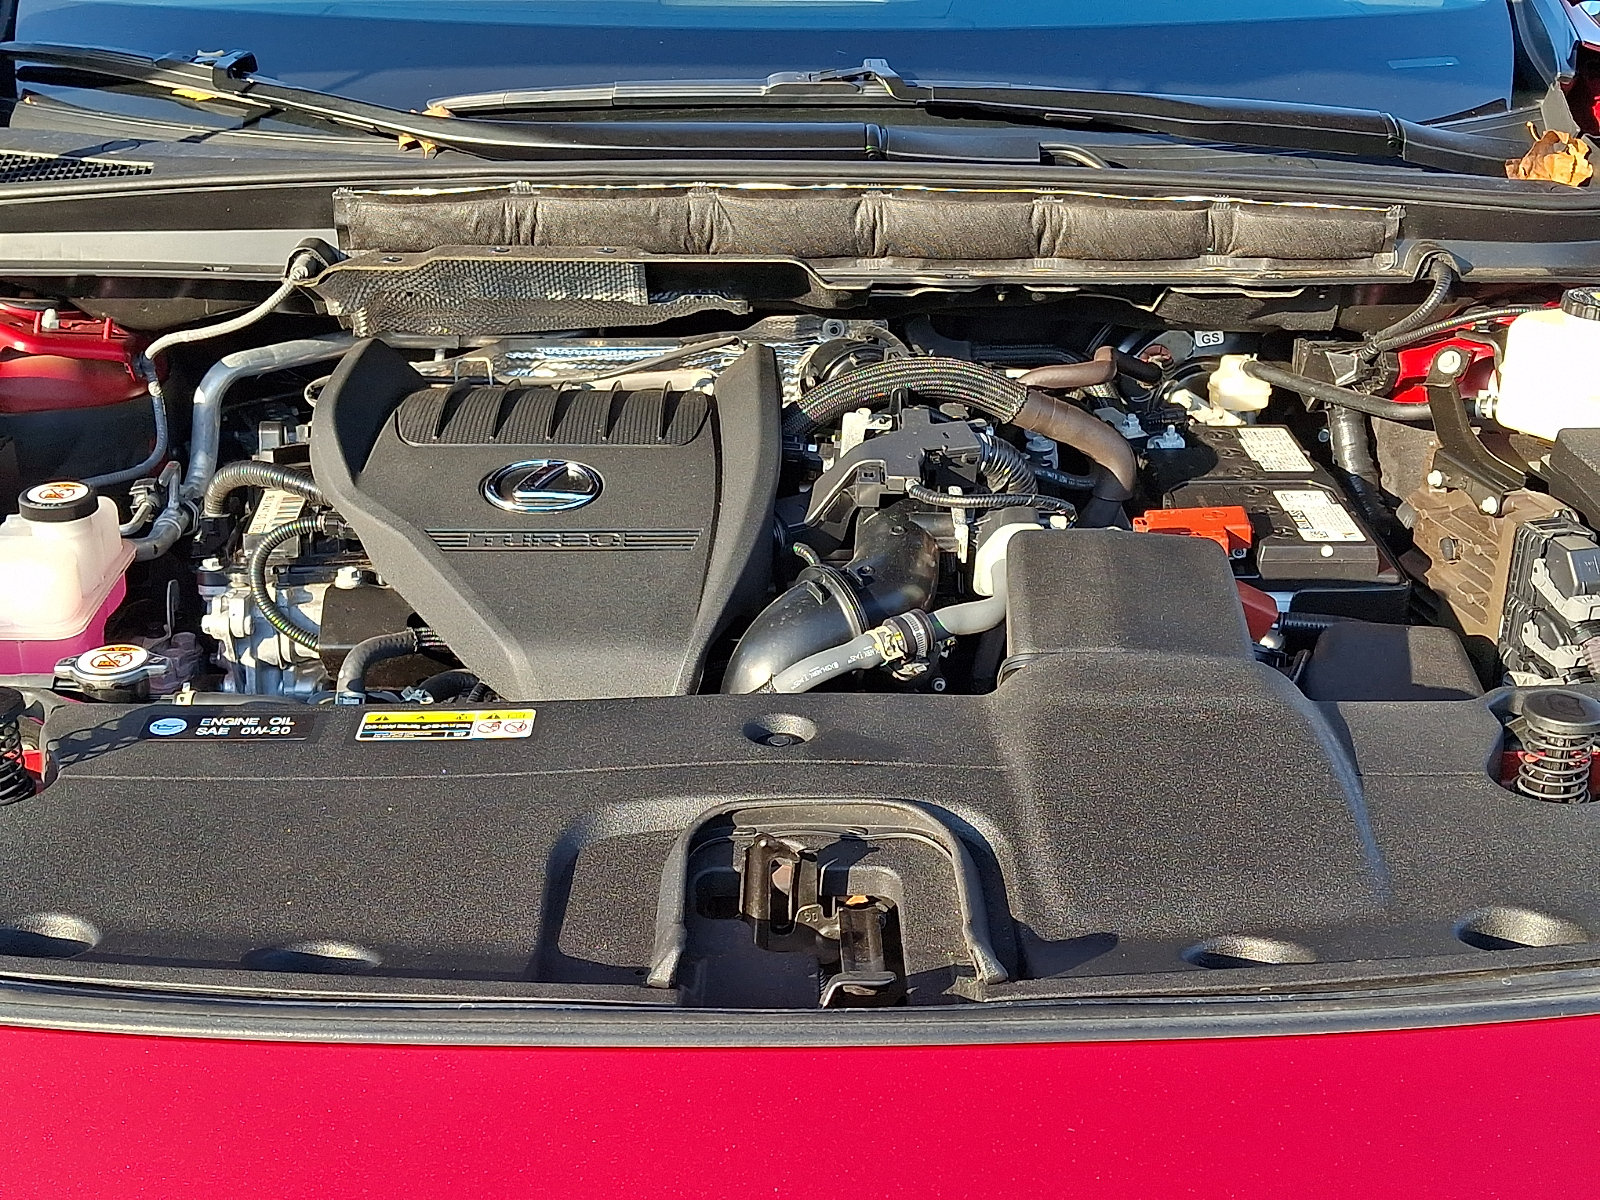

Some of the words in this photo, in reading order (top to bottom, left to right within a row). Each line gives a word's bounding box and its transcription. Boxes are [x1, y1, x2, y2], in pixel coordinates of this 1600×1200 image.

[1201, 332, 1220, 344] GS
[473, 532, 621, 548] TURBO
[200, 717, 260, 726] ENGINE
[269, 716, 296, 726] OIL
[195, 726, 230, 736] SAE
[240, 726, 291, 735] 0W-20
